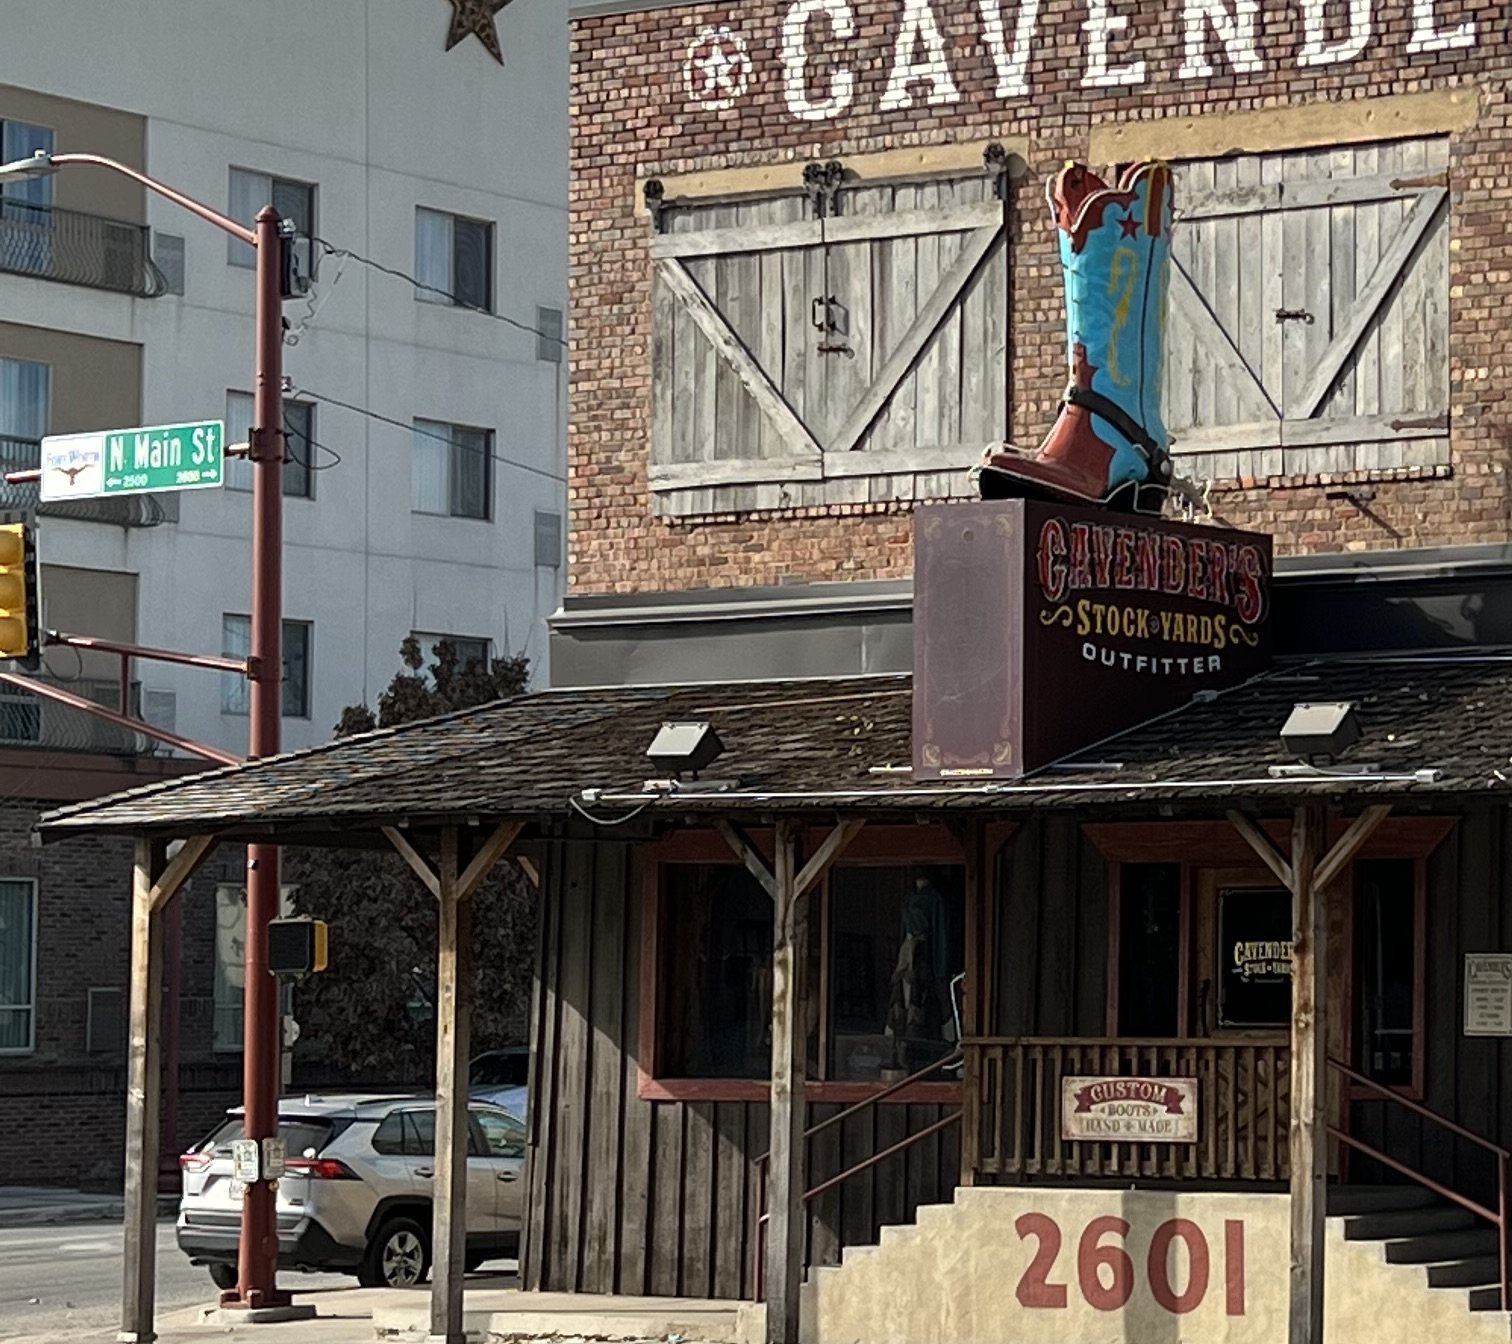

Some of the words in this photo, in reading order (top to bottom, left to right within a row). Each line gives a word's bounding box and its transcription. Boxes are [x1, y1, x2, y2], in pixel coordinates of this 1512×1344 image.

[134, 431, 181, 470] Main
[191, 427, 216, 465] St
[1037, 518, 1263, 624] CAVENDER'S
[1077, 599, 1150, 639] STOCK
[1160, 610, 1226, 649] YARDS
[1082, 643, 1221, 675] OUTFITTER
[1090, 1081, 1167, 1103] CUSTOM
[1108, 1104, 1151, 1117] BOOTS
[1014, 1212, 1246, 1317] 2601
